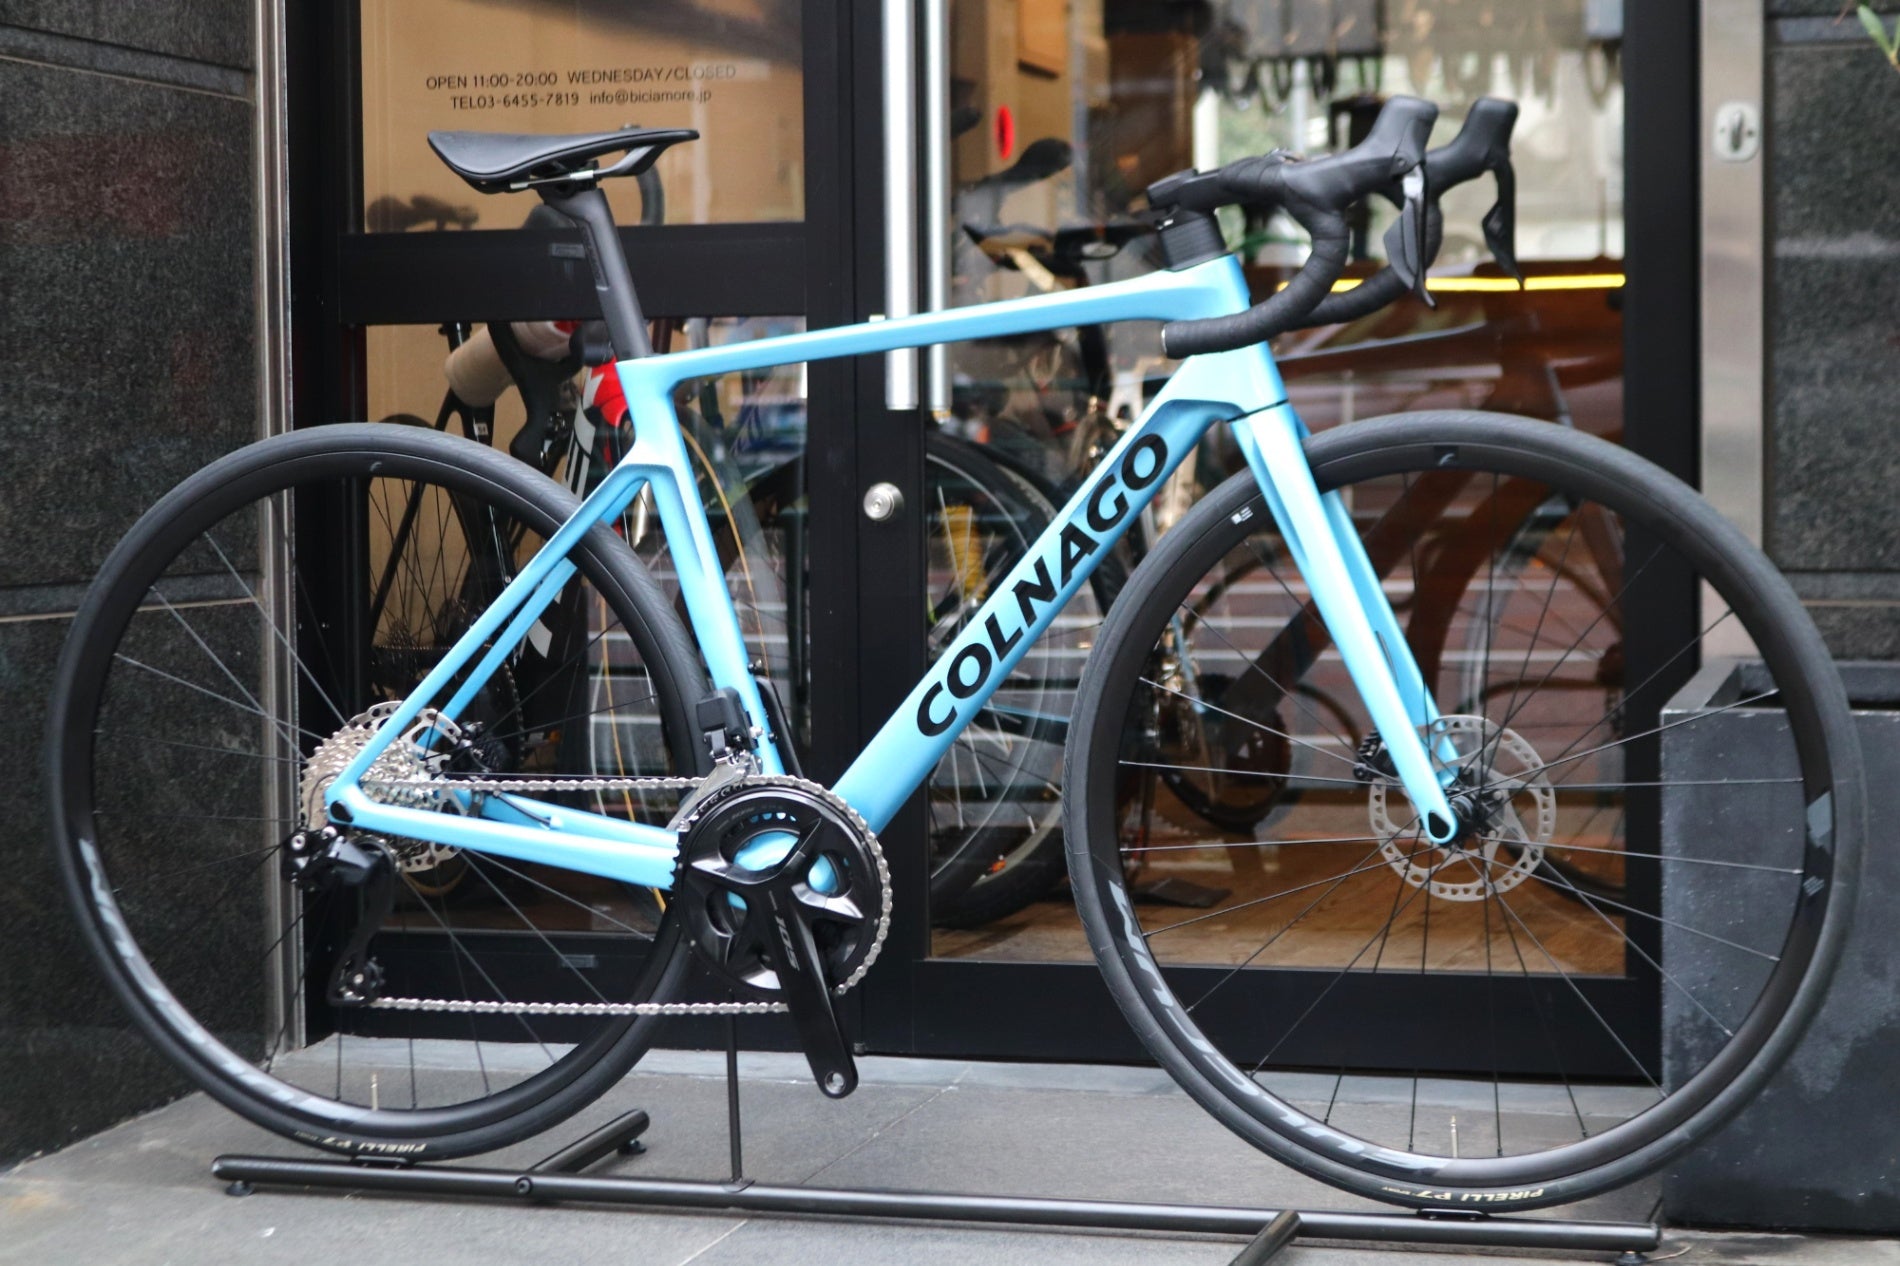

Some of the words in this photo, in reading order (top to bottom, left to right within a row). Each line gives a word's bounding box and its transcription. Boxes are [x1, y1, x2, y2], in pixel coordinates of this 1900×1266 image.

[426, 75, 467, 90] OPEN
[473, 71, 558, 88] 11:00-20:00
[567, 65, 736, 84] WEDNESDAY/CLOSED
[450, 92, 579, 110] TEL03-6455-7819
[590, 89, 712, 105] info@biciamore.jp
[917, 433, 1168, 737] COLNAGO
[774, 915, 800, 972] 105
[322, 1136, 352, 1148] P7
[358, 1142, 427, 1153] PIRELLI
[1416, 1190, 1452, 1201] P7
[1461, 1188, 1545, 1202] PIRELLI
